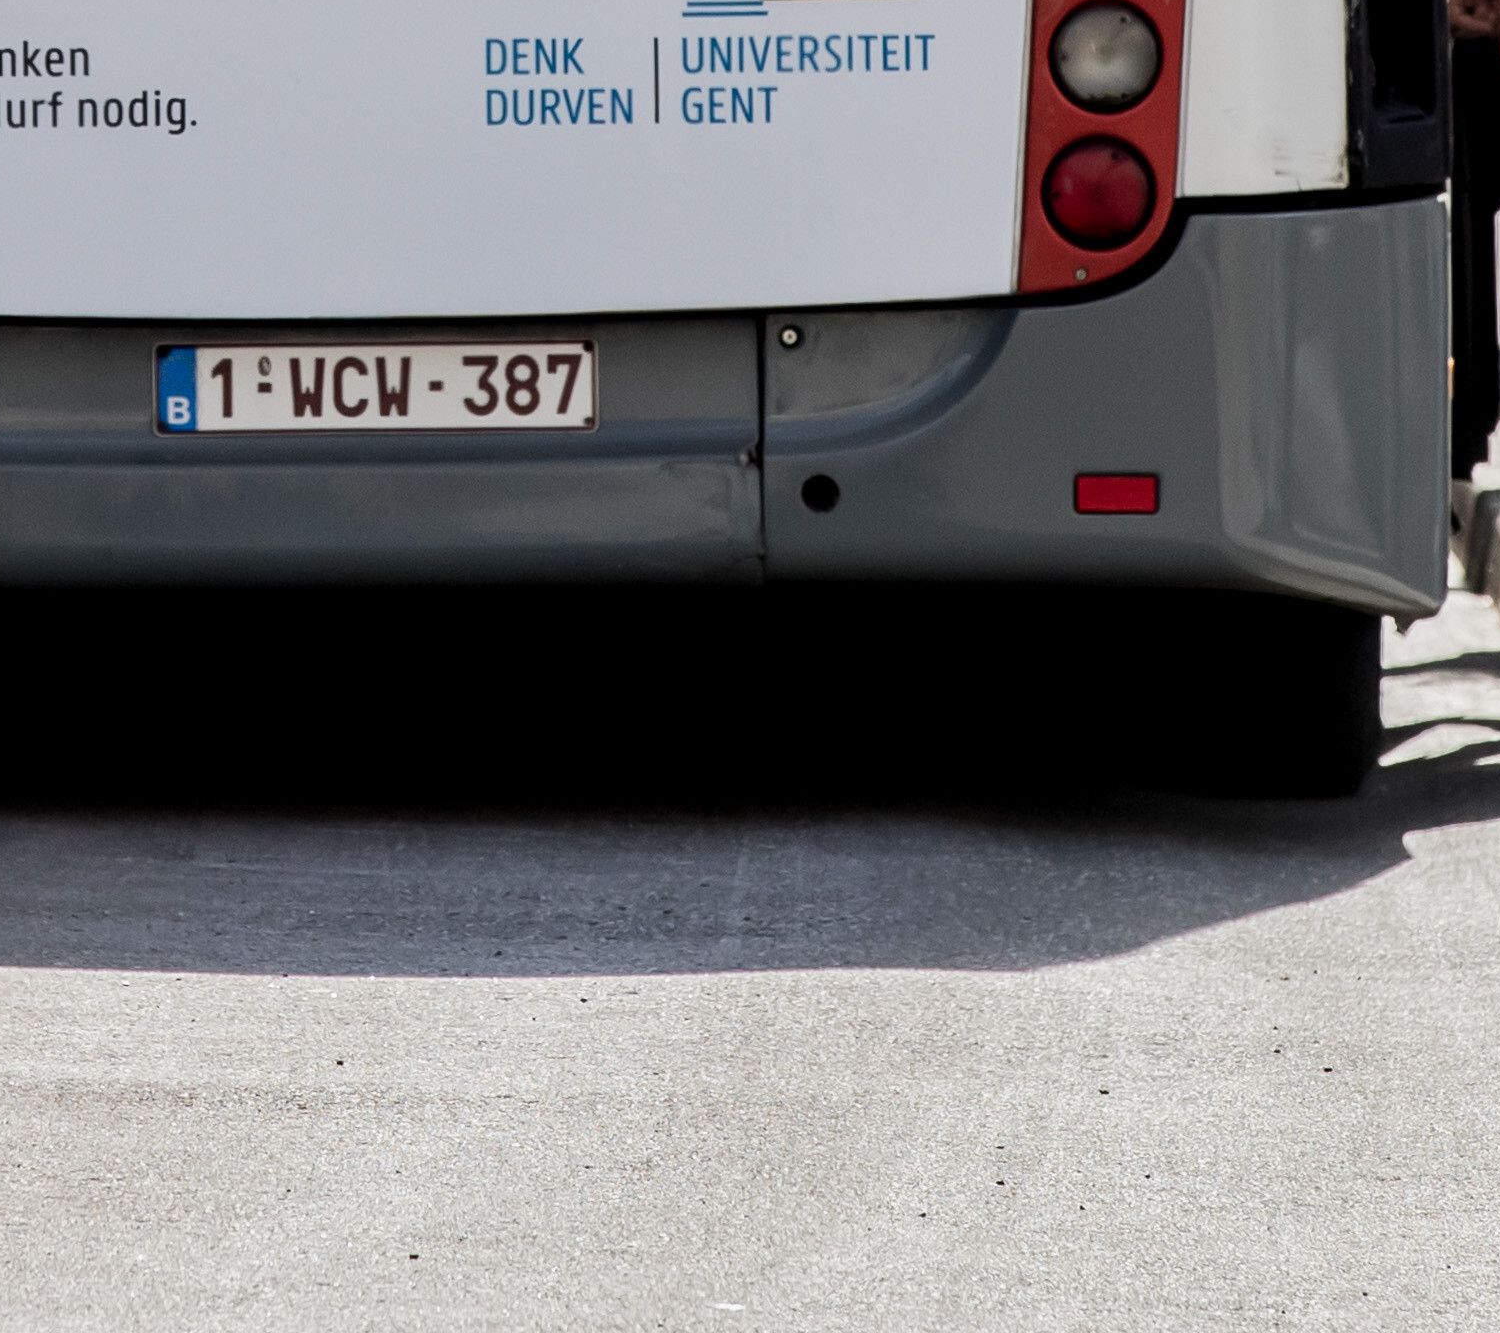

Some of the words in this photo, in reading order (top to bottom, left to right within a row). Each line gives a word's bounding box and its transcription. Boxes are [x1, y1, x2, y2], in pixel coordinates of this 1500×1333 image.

[485, 38, 585, 75] DENK
[681, 34, 936, 74] UNIVERSITEIT
[78, 89, 198, 135] nodig.
[485, 87, 634, 126] DURVEN
[681, 86, 778, 124] GENT
[166, 397, 191, 425] B
[211, 354, 583, 418] 1-WCW-387
